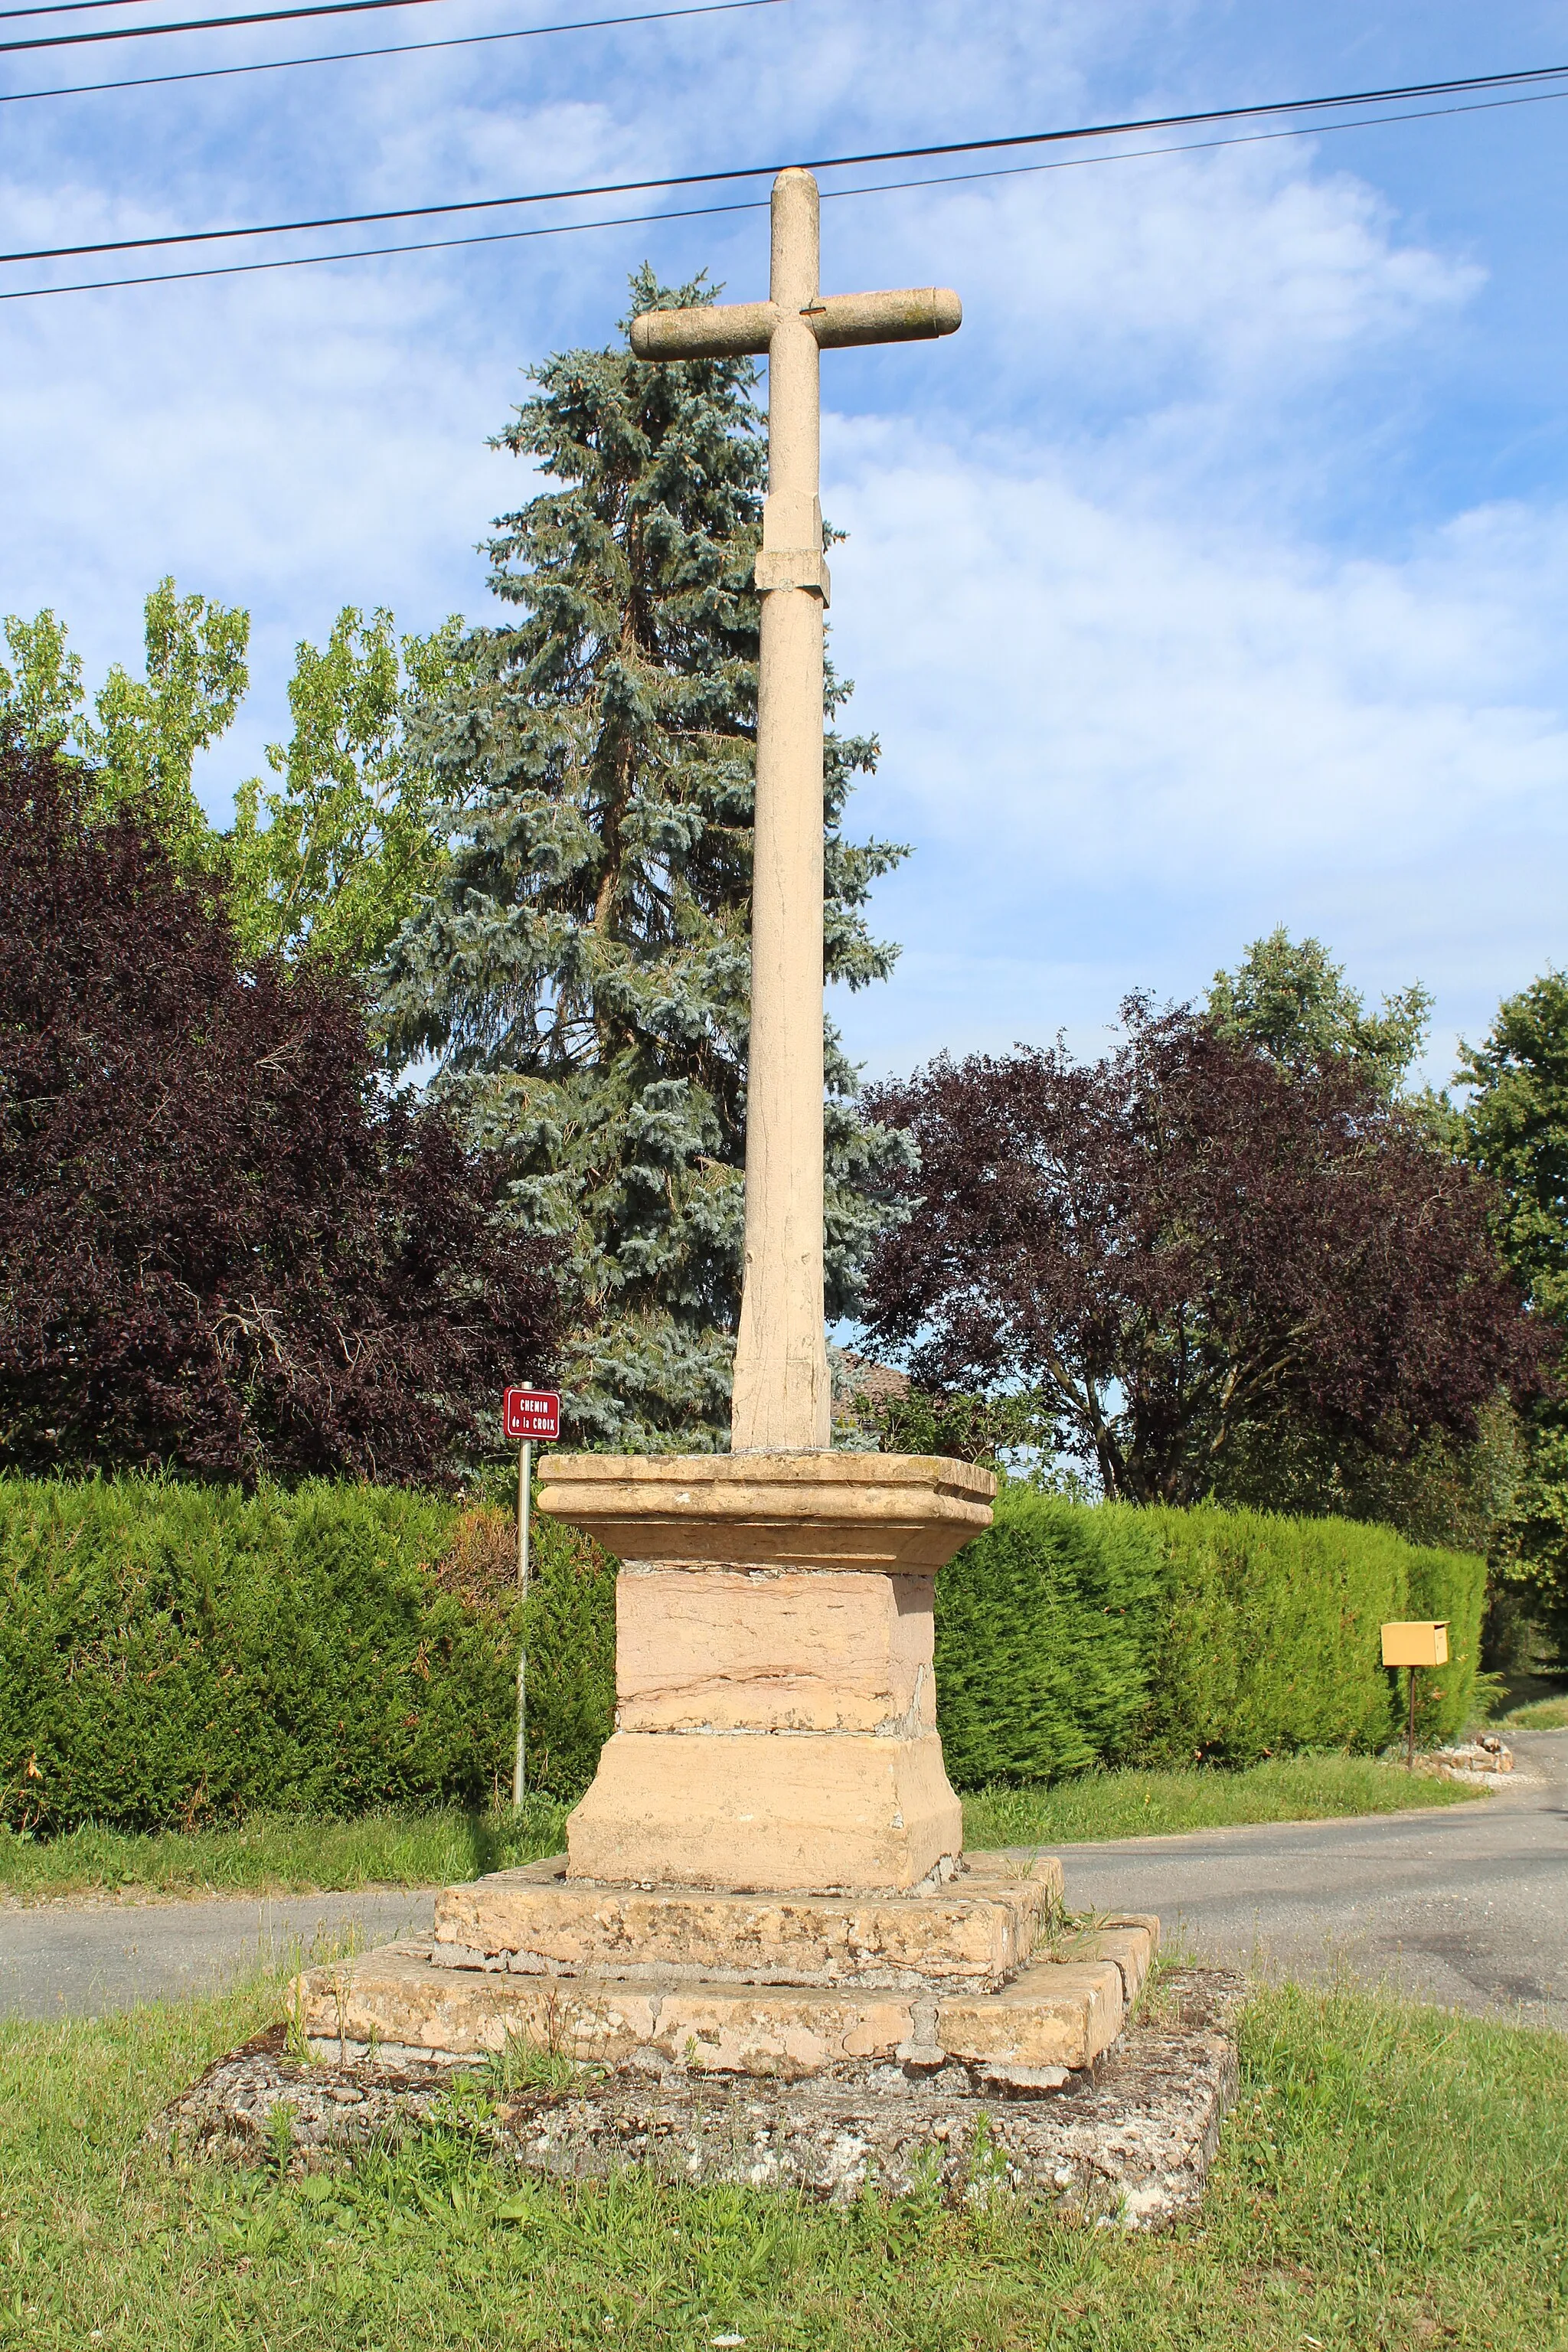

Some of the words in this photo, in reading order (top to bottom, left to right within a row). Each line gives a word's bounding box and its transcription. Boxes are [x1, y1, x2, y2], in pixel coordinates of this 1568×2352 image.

[520, 1399, 548, 1413] CHEMIN
[511, 1416, 520, 1428] de
[523, 1416, 530, 1429] la
[533, 1417, 555, 1431] CROIX
